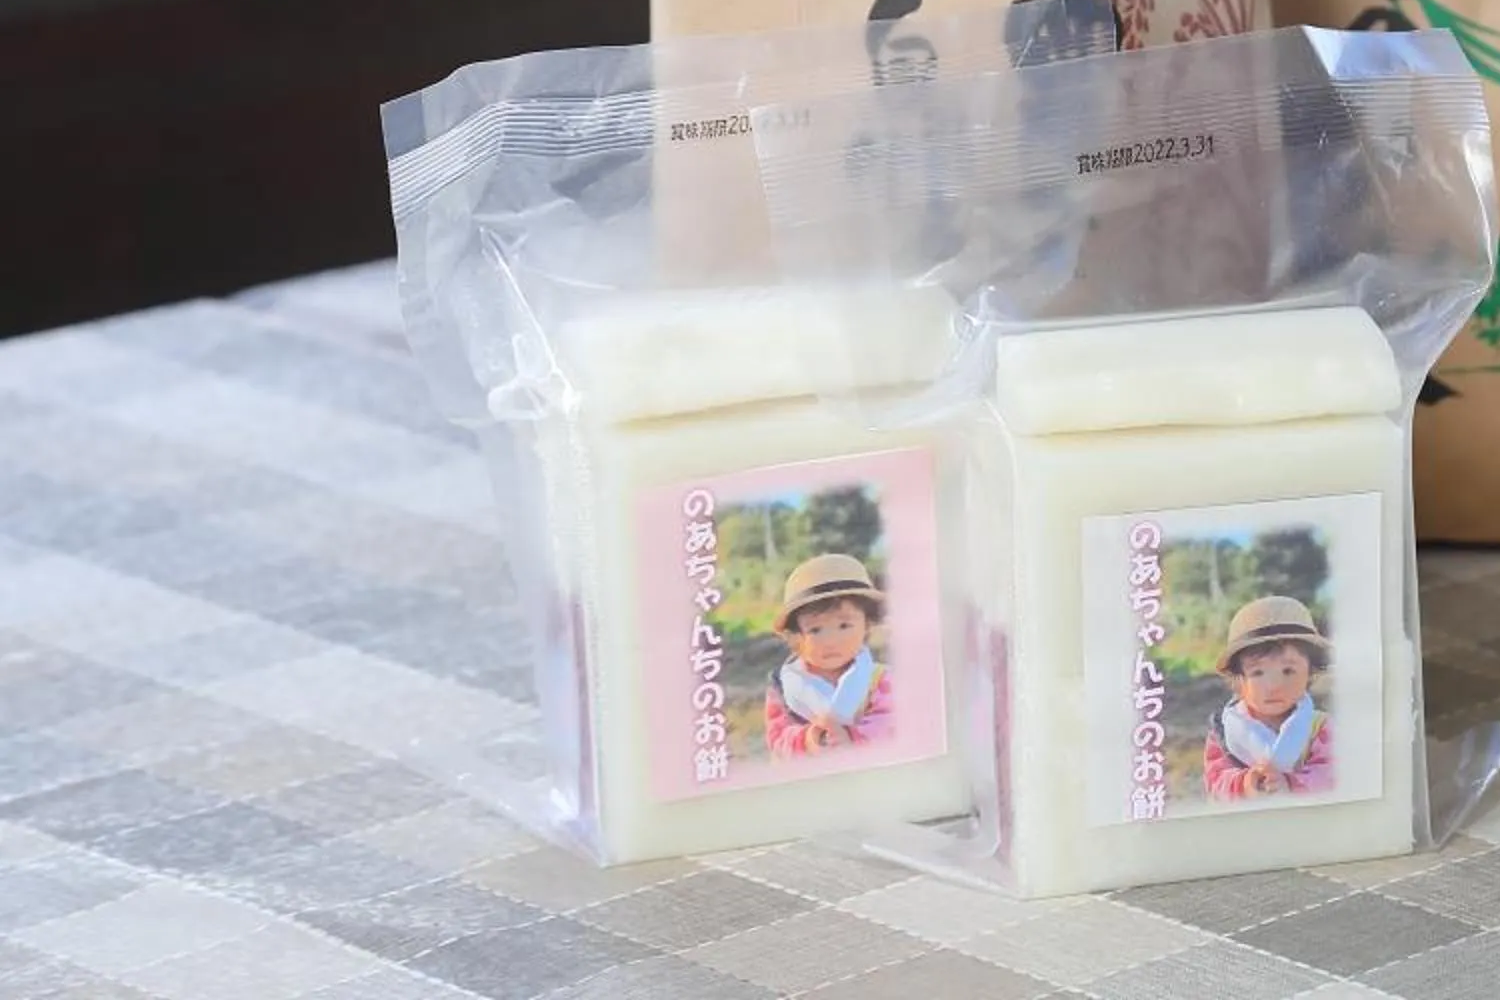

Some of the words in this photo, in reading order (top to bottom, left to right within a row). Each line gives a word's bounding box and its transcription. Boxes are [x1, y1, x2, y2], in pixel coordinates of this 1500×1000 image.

[682, 488, 729, 783] のあちゃんちのお餅
[1128, 521, 1166, 821] のあちゃんちのお餅
